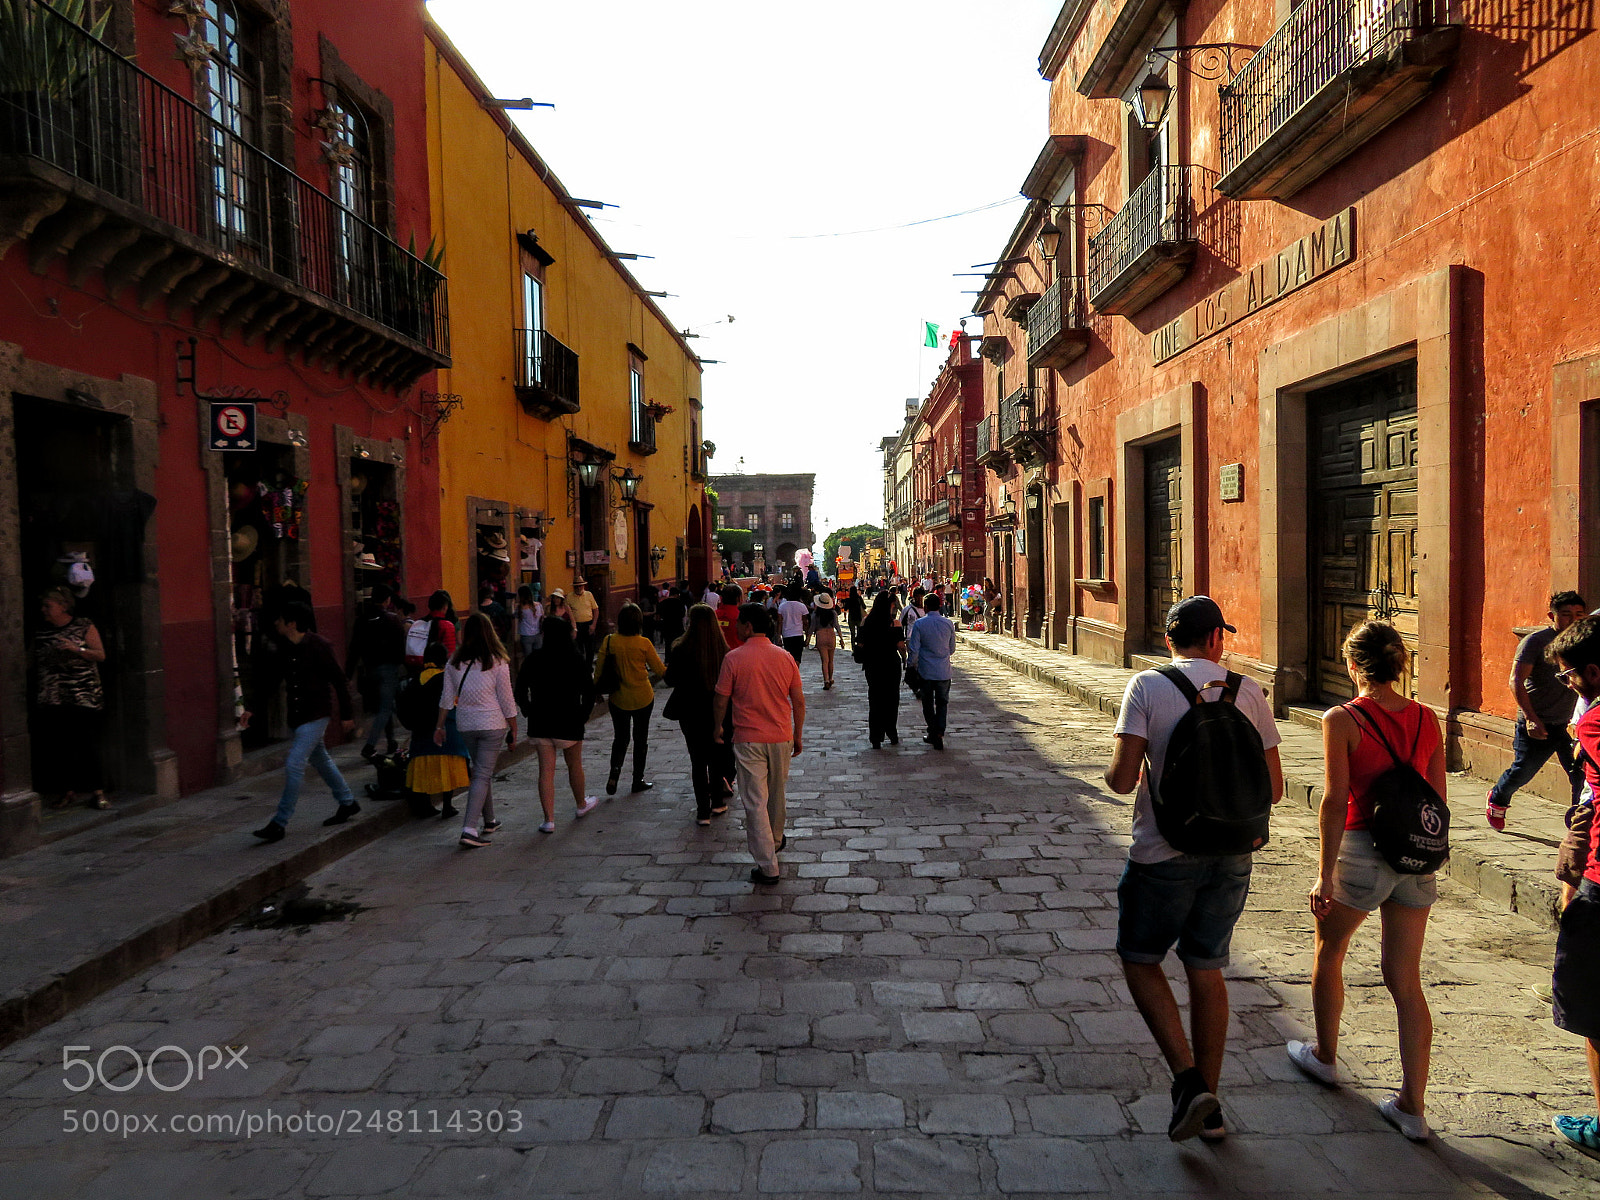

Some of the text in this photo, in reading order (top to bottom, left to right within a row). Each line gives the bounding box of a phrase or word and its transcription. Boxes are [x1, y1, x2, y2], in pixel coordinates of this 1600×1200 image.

[1152, 215, 1346, 362] CINE LOS ALDAMA
[226, 414, 238, 430] E
